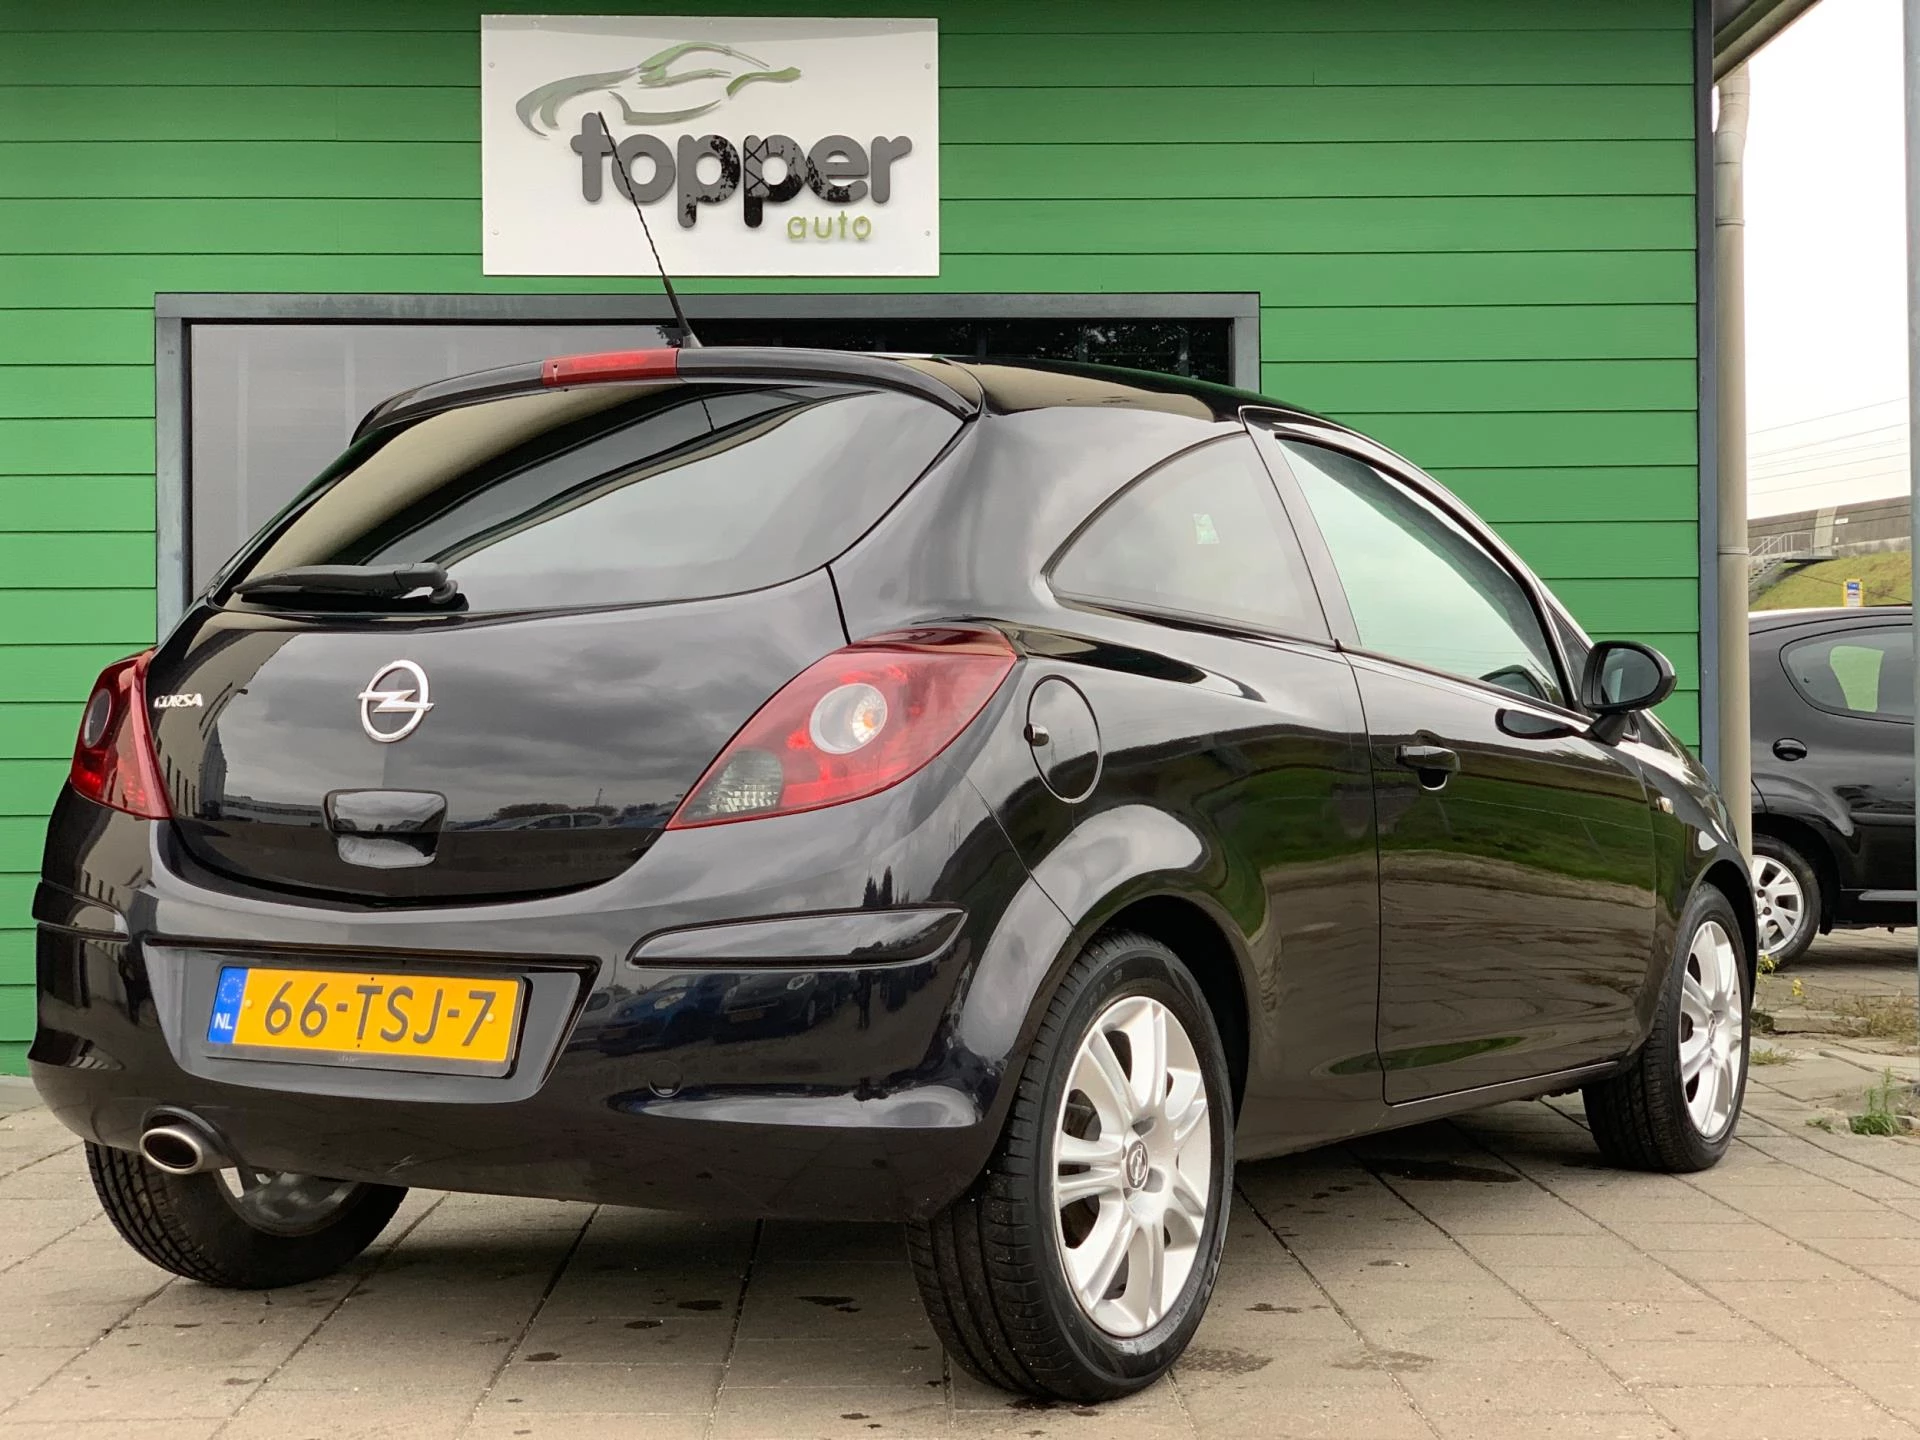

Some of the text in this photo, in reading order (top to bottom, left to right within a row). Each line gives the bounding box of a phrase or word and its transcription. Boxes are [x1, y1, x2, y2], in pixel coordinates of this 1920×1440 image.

[570, 112, 912, 228] topper
[787, 210, 872, 240] auto
[213, 1012, 233, 1031] NL
[264, 980, 497, 1047] 66-TSJ-7
